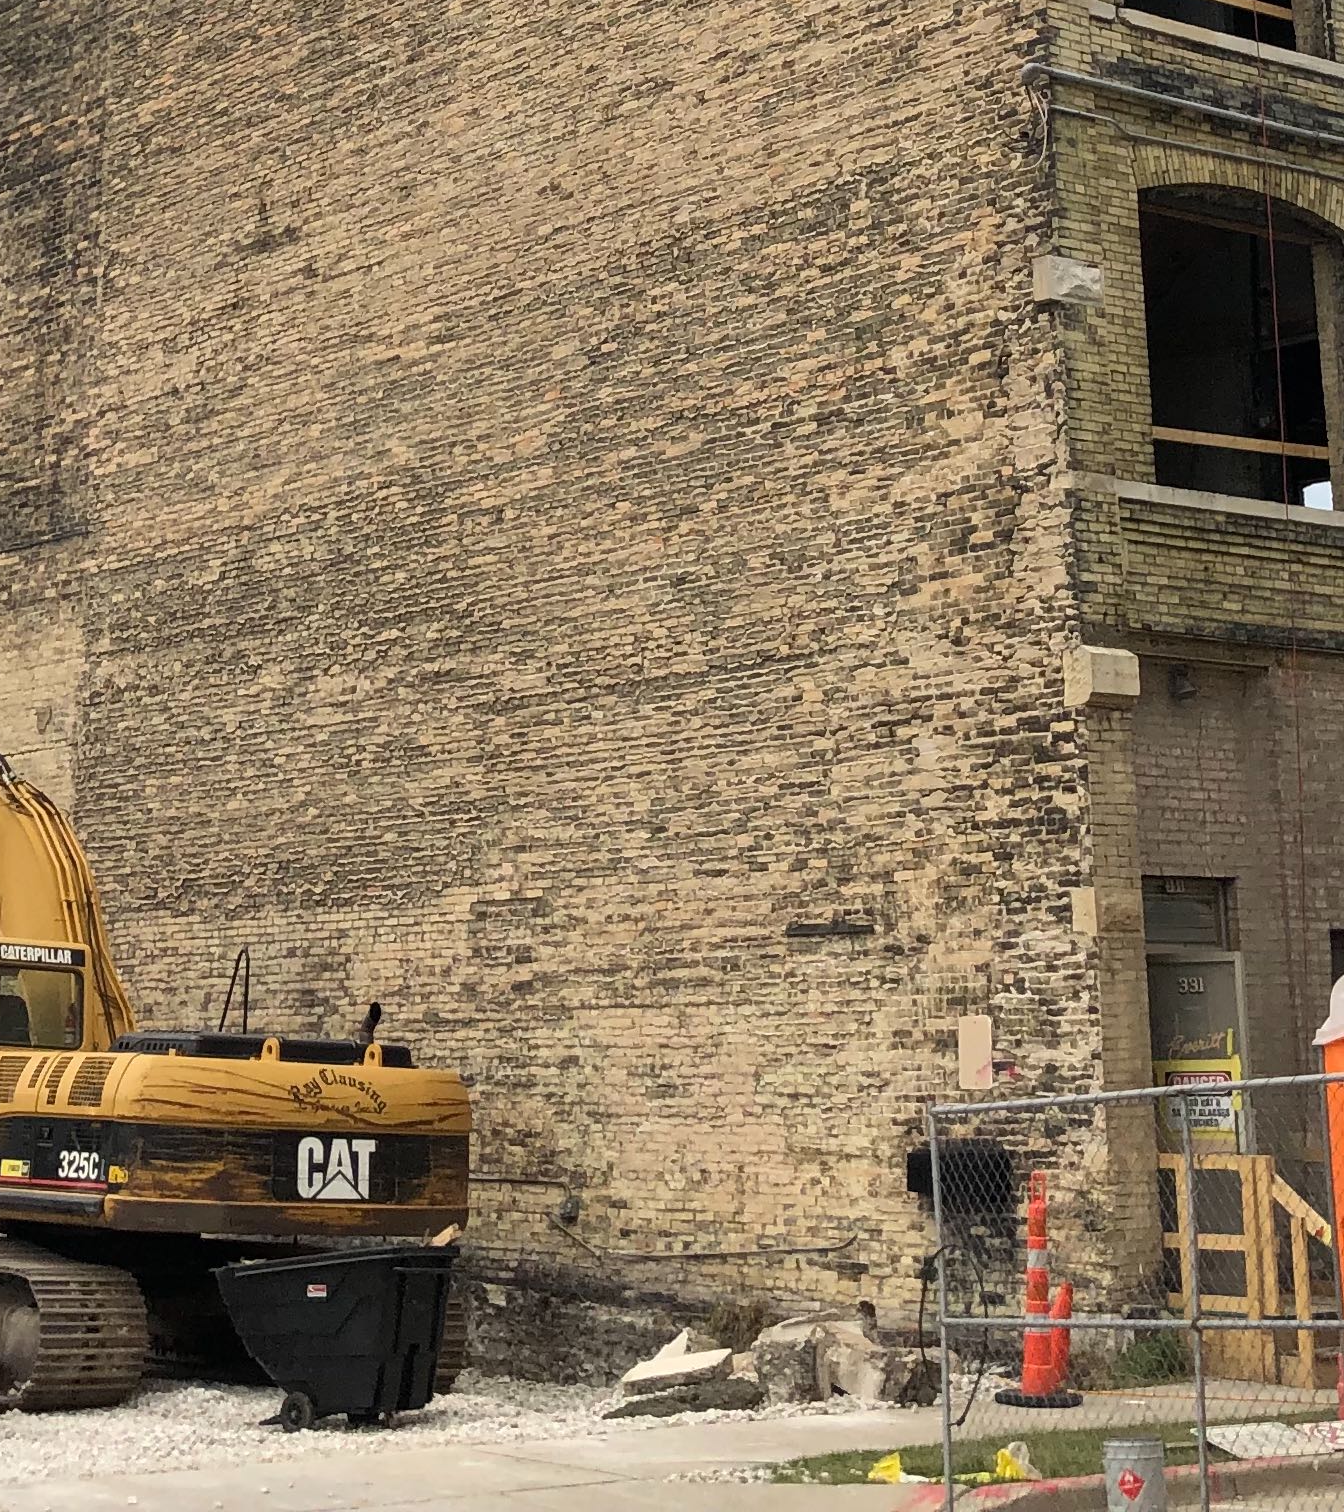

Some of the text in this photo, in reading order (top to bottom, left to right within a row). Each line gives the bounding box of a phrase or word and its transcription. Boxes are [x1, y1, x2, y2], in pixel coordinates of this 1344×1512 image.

[0, 945, 72, 964] CATERPILLAR
[288, 1068, 387, 1114] Ray Clausing
[58, 1150, 99, 1180] 325C
[297, 1137, 376, 1199] CAT
